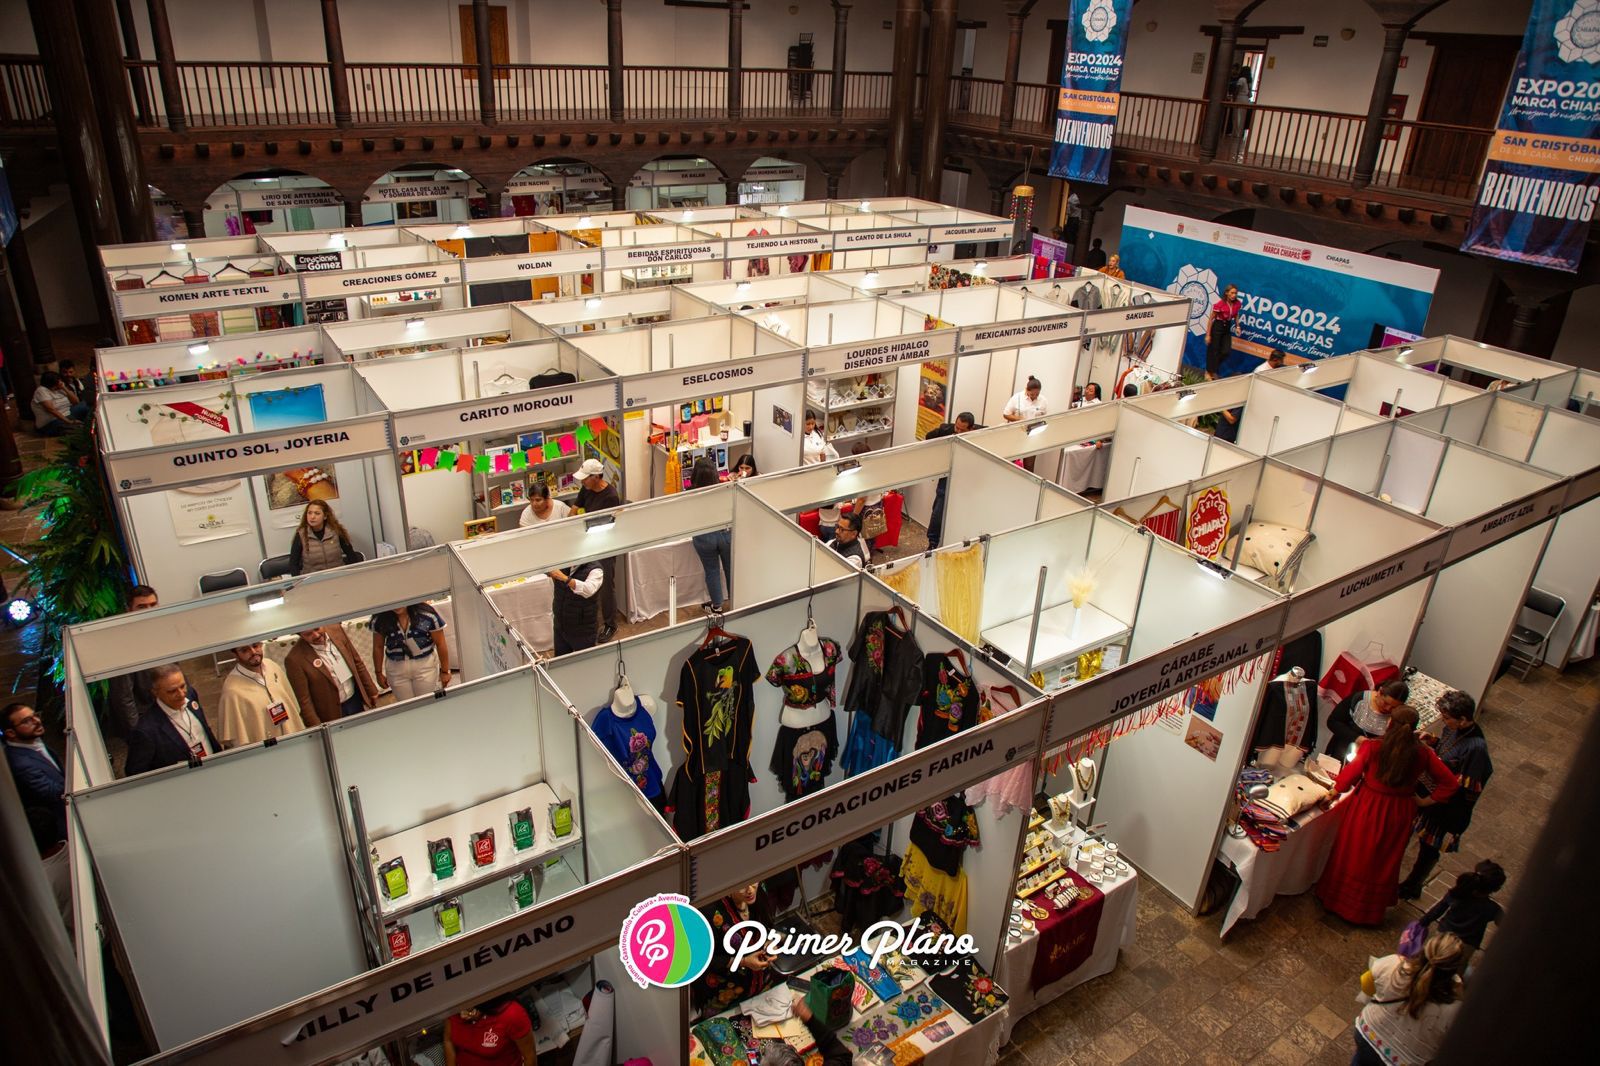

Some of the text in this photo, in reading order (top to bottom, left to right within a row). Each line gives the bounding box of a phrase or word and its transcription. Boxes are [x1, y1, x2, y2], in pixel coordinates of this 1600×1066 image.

[1067, 52, 1123, 66] EXPO2024
[1065, 64, 1120, 75] MARCA CHIAPAS
[1063, 92, 1078, 100] SAN
[1511, 95, 1557, 109] MARCA
[1055, 118, 1114, 150] BIENVENIDOS
[1503, 135, 1528, 147] SAN
[294, 191, 335, 199] ARTESANAS
[1480, 171, 1599, 222] BIENVENIDOS
[944, 228, 976, 236] JACQUELINE
[746, 241, 778, 249] TEJIENDO
[789, 238, 818, 246] HISTORIA
[299, 254, 338, 264] Creaciones
[627, 246, 711, 258] BEBIDAS ESPIRITUOSAS
[647, 252, 693, 262] DON CARLOS
[1263, 245, 1280, 255] MARCA
[1280, 249, 1301, 260] CHIAPAS
[1326, 254, 1350, 265] CHIAPAS
[307, 260, 341, 271] Gómez
[517, 261, 552, 270] WOLDAN
[343, 270, 437, 287] CREACIONES GÓMEZ
[159, 285, 269, 303] KOMEN ARTE TEXTIL
[1125, 310, 1155, 321] SAKUBEL
[975, 321, 1068, 341] MEXICANITAS SOUVENIRS
[1238, 314, 1272, 333] ARCA
[1275, 324, 1334, 349] CHIAPAS
[846, 340, 929, 360] LOURDES HIDALGO
[844, 348, 930, 370] DISEÑOS EN ÁMBAR
[682, 366, 754, 386] ESELCOSMOS
[201, 409, 222, 421] Nueva
[459, 394, 573, 423] CARITO MOROQUI
[173, 431, 350, 467] QUINTO SOL, JOYERIA
[1191, 515, 1226, 539] CHIAPAS
[1160, 643, 1215, 677] CÁRABE
[1110, 642, 1250, 715] JOYERÍA ARTESANAL
[754, 739, 995, 852] DECORACIONES FARINA
[391, 971, 437, 1003] DE
[444, 914, 576, 982] LIÉVANO
